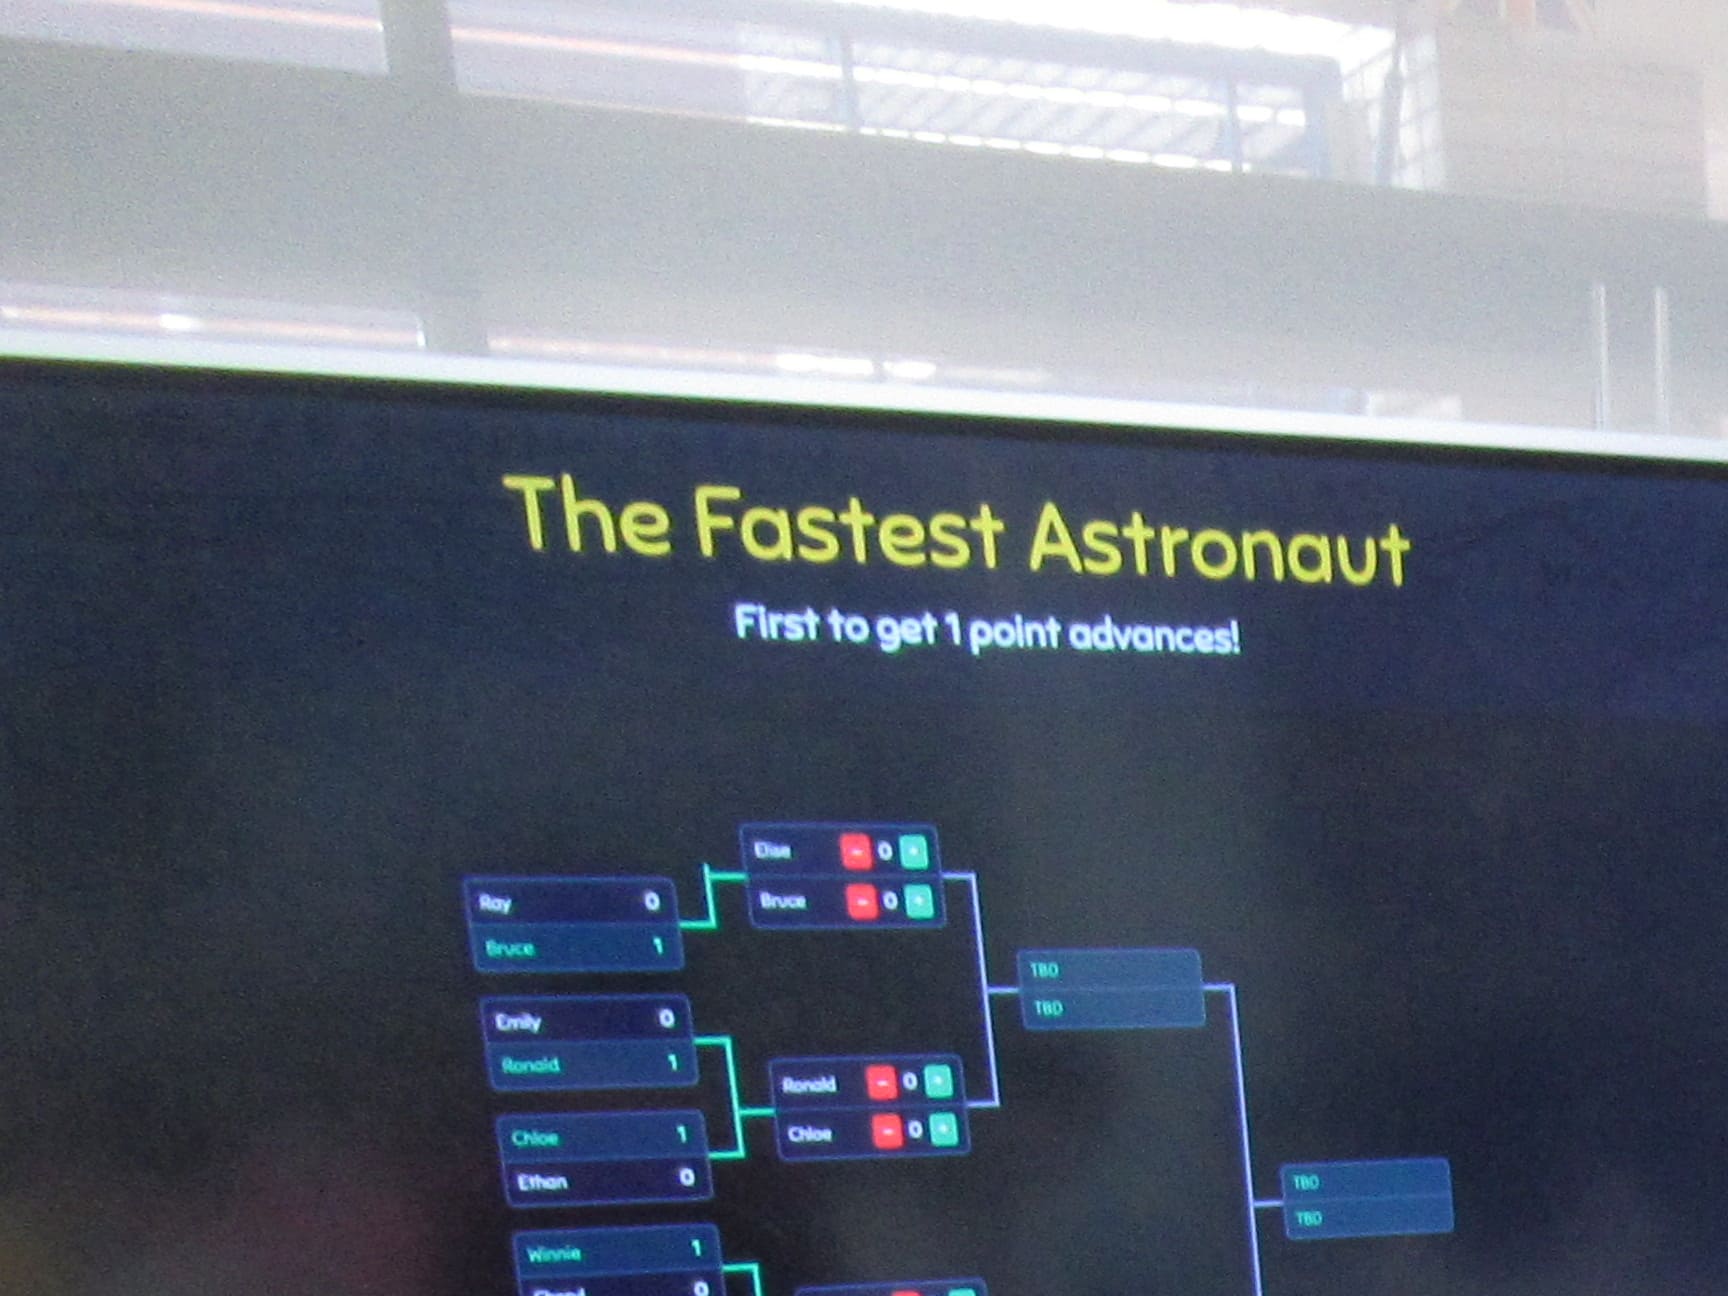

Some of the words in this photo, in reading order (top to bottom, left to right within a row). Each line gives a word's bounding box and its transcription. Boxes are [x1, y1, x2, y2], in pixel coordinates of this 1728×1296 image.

[501, 473, 672, 557] The
[694, 484, 1006, 569] Fastest
[1029, 501, 1411, 587] Astronaut
[734, 603, 819, 645] First
[828, 608, 871, 645] to
[875, 612, 940, 653] get
[945, 613, 960, 647] 1
[969, 613, 1062, 656] point
[1068, 619, 1240, 655] advances!
[878, 841, 892, 860] 0
[645, 892, 660, 911] 0
[884, 892, 898, 910] 0
[653, 937, 663, 955] 1
[659, 1009, 674, 1027] 0
[667, 1054, 677, 1071] 1
[903, 1072, 917, 1090] 0
[677, 1125, 687, 1143] 1
[909, 1121, 922, 1138] 0
[680, 1168, 695, 1186] 0
[691, 1239, 701, 1256] 1
